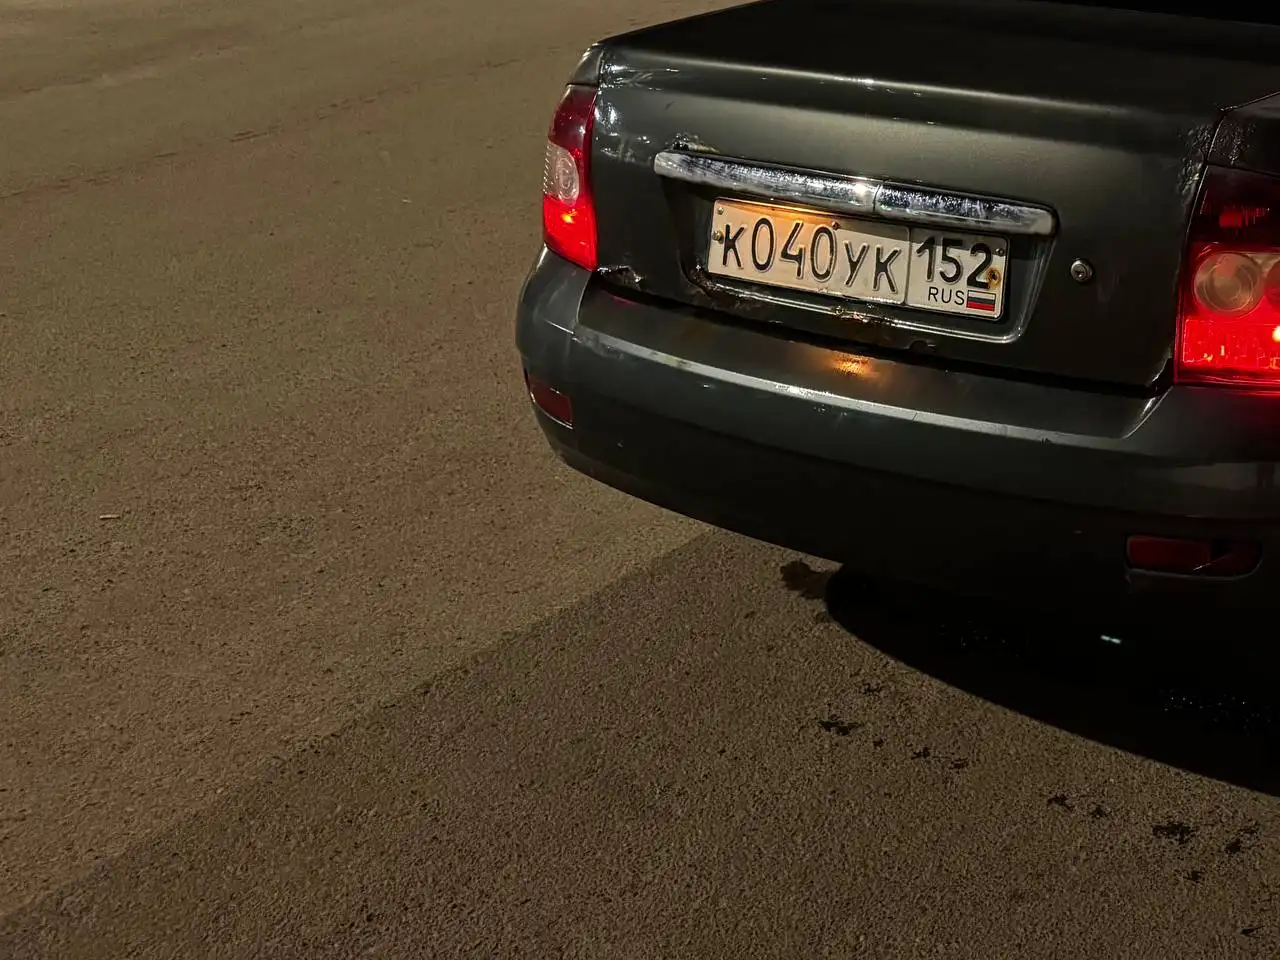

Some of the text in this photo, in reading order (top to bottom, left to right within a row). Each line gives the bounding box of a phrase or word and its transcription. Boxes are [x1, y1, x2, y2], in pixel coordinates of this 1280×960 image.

[721, 217, 994, 294] К040УК 152
[927, 286, 966, 306] RUS
